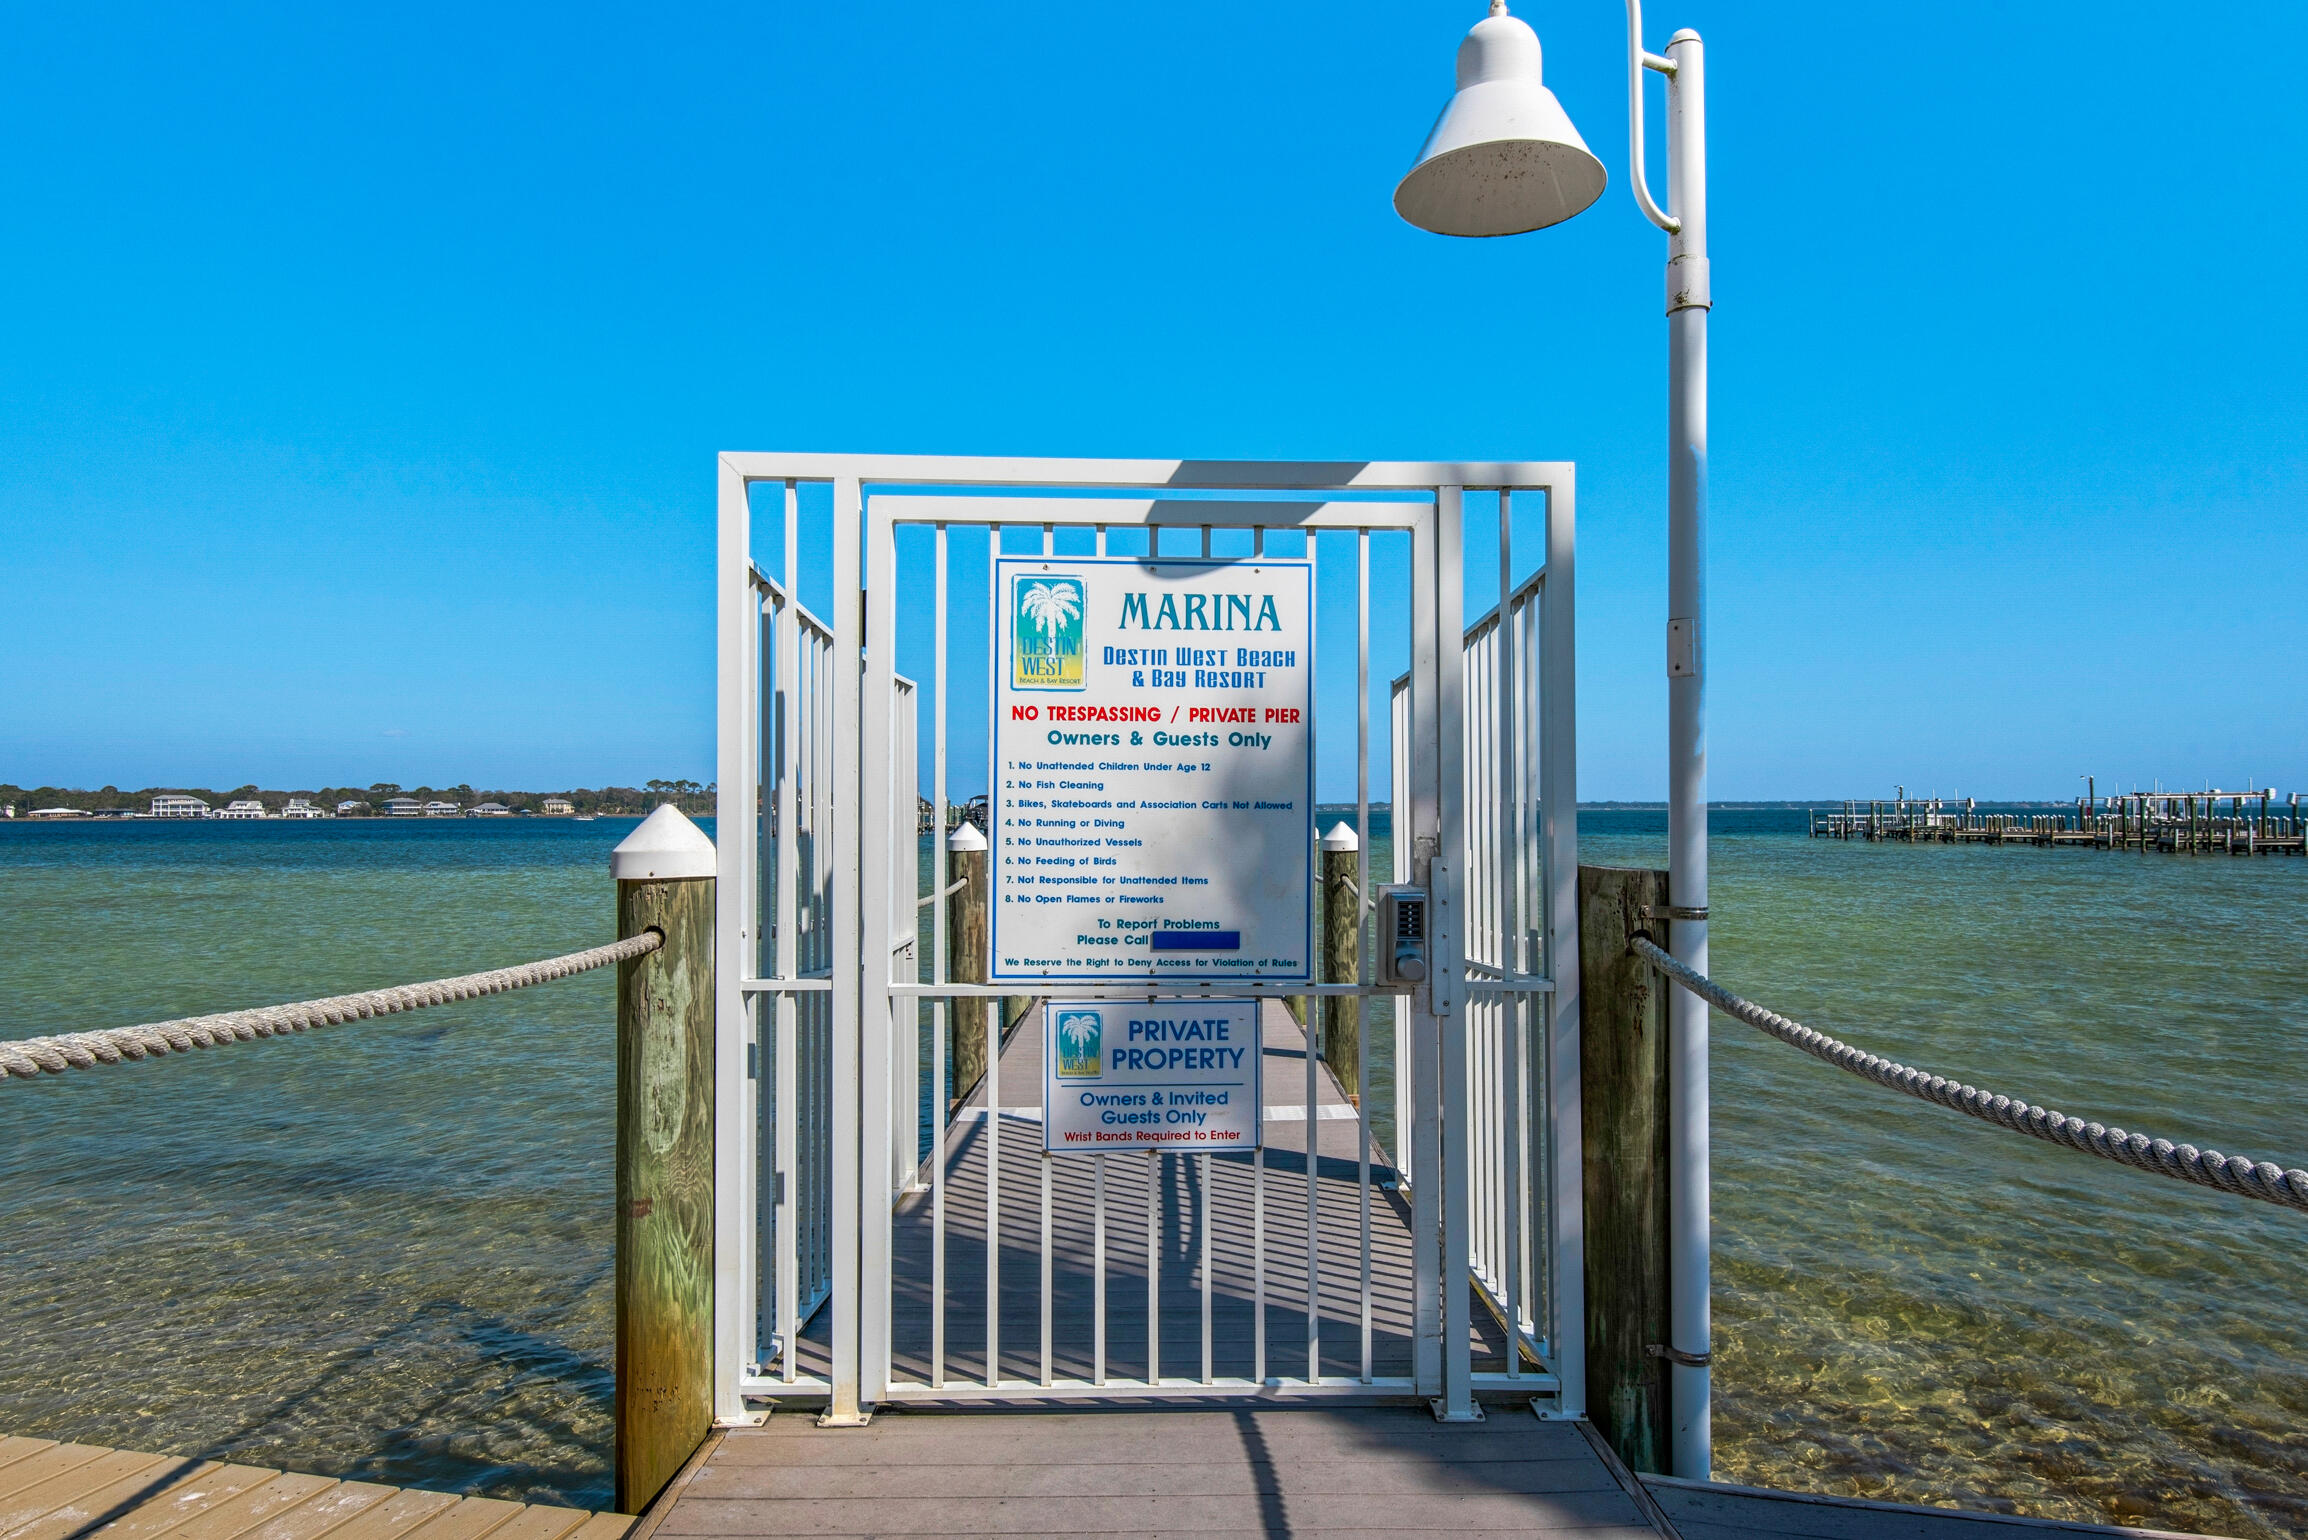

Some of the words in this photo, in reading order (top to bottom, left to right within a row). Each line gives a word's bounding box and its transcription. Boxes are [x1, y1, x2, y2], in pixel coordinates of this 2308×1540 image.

[1119, 593, 1281, 631] MARINA
[1022, 637, 1076, 655] DESTIN
[1022, 657, 1064, 675] WEST
[1133, 671, 1144, 687] &
[1012, 706, 1038, 720] NO
[1047, 706, 1161, 722] TRESPASSING
[1171, 706, 1179, 723] /
[1190, 708, 1256, 723] PRIVATE
[1265, 708, 1300, 723] PIER
[1048, 730, 1120, 745] Owners
[1130, 731, 1143, 745] &
[1153, 731, 1219, 746] Guests
[1229, 732, 1271, 750] Only
[1008, 760, 1014, 770] 1.
[1018, 762, 1032, 770] No
[1036, 762, 1094, 771] Unattended
[1098, 762, 1140, 771] Children
[1144, 762, 1172, 771] Under
[1176, 762, 1196, 774] Age
[1200, 762, 1210, 772] 12
[1006, 780, 1014, 789] 2.
[1018, 780, 1032, 789] No
[1036, 780, 1056, 789] Fish
[1060, 780, 1104, 792] Cleaning
[1006, 800, 1014, 808] 3.
[1018, 800, 1046, 810] Bikes,
[1052, 800, 1112, 809] Skateboards
[1116, 800, 1136, 809] and
[1140, 800, 1196, 809] Association
[1202, 800, 1230, 810] Carts
[1232, 800, 1250, 810] Not
[1254, 800, 1292, 810] Allowed
[1004, 818, 1014, 827] 4.
[1018, 818, 1032, 827] No
[1036, 818, 1076, 830] Running
[1094, 818, 1124, 830] Diving
[1006, 838, 1014, 846] 5.
[1018, 838, 1032, 846] No
[1036, 838, 1100, 847] Unauthorized
[1106, 838, 1142, 847] Vessels
[1006, 856, 1014, 865] 6.
[1018, 856, 1032, 865] No
[1036, 856, 1076, 868] Feeding
[1078, 856, 1088, 866] of
[1094, 856, 1116, 866] Birds
[1006, 876, 1014, 884] 7.
[1018, 876, 1034, 884] Not
[1040, 876, 1098, 886] Responsible
[1102, 876, 1116, 885] for
[1120, 876, 1178, 885] Unattended
[1182, 876, 1208, 885] Items
[1004, 894, 1014, 903] 8.
[1018, 894, 1032, 903] No
[1036, 894, 1062, 905] Open
[1066, 894, 1100, 904] Flames
[1120, 894, 1164, 904] Fireworks
[1098, 918, 1110, 929] To
[1117, 919, 1157, 931] Report
[1164, 918, 1220, 930] Problems
[1078, 934, 1118, 945] Please
[1124, 934, 1148, 945] Call
[1004, 958, 1020, 967] We
[1024, 958, 1062, 967] Reserve
[1066, 958, 1082, 967] the
[1086, 958, 1110, 969] Right
[1114, 958, 1124, 967] to
[1128, 958, 1152, 968] Deny
[1156, 958, 1192, 967] Access
[1196, 958, 1208, 967] for
[1212, 958, 1254, 967] Violation
[1258, 958, 1268, 968] of
[1272, 958, 1298, 968] Rules
[1129, 1020, 1229, 1041] PRIVATE
[1063, 1059, 1088, 1070] WEST
[1113, 1048, 1245, 1070] PROPERTY
[1080, 1093, 1146, 1106] Owners
[1152, 1092, 1163, 1105] &
[1170, 1091, 1228, 1105] Invited
[1101, 1110, 1160, 1124] Guests
[1166, 1109, 1206, 1126] Only
[1065, 1132, 1092, 1141] Wrist
[1096, 1131, 1132, 1141] Bands
[1136, 1131, 1190, 1142] Required
[1195, 1131, 1206, 1140] to
[1211, 1130, 1240, 1139] Enter
